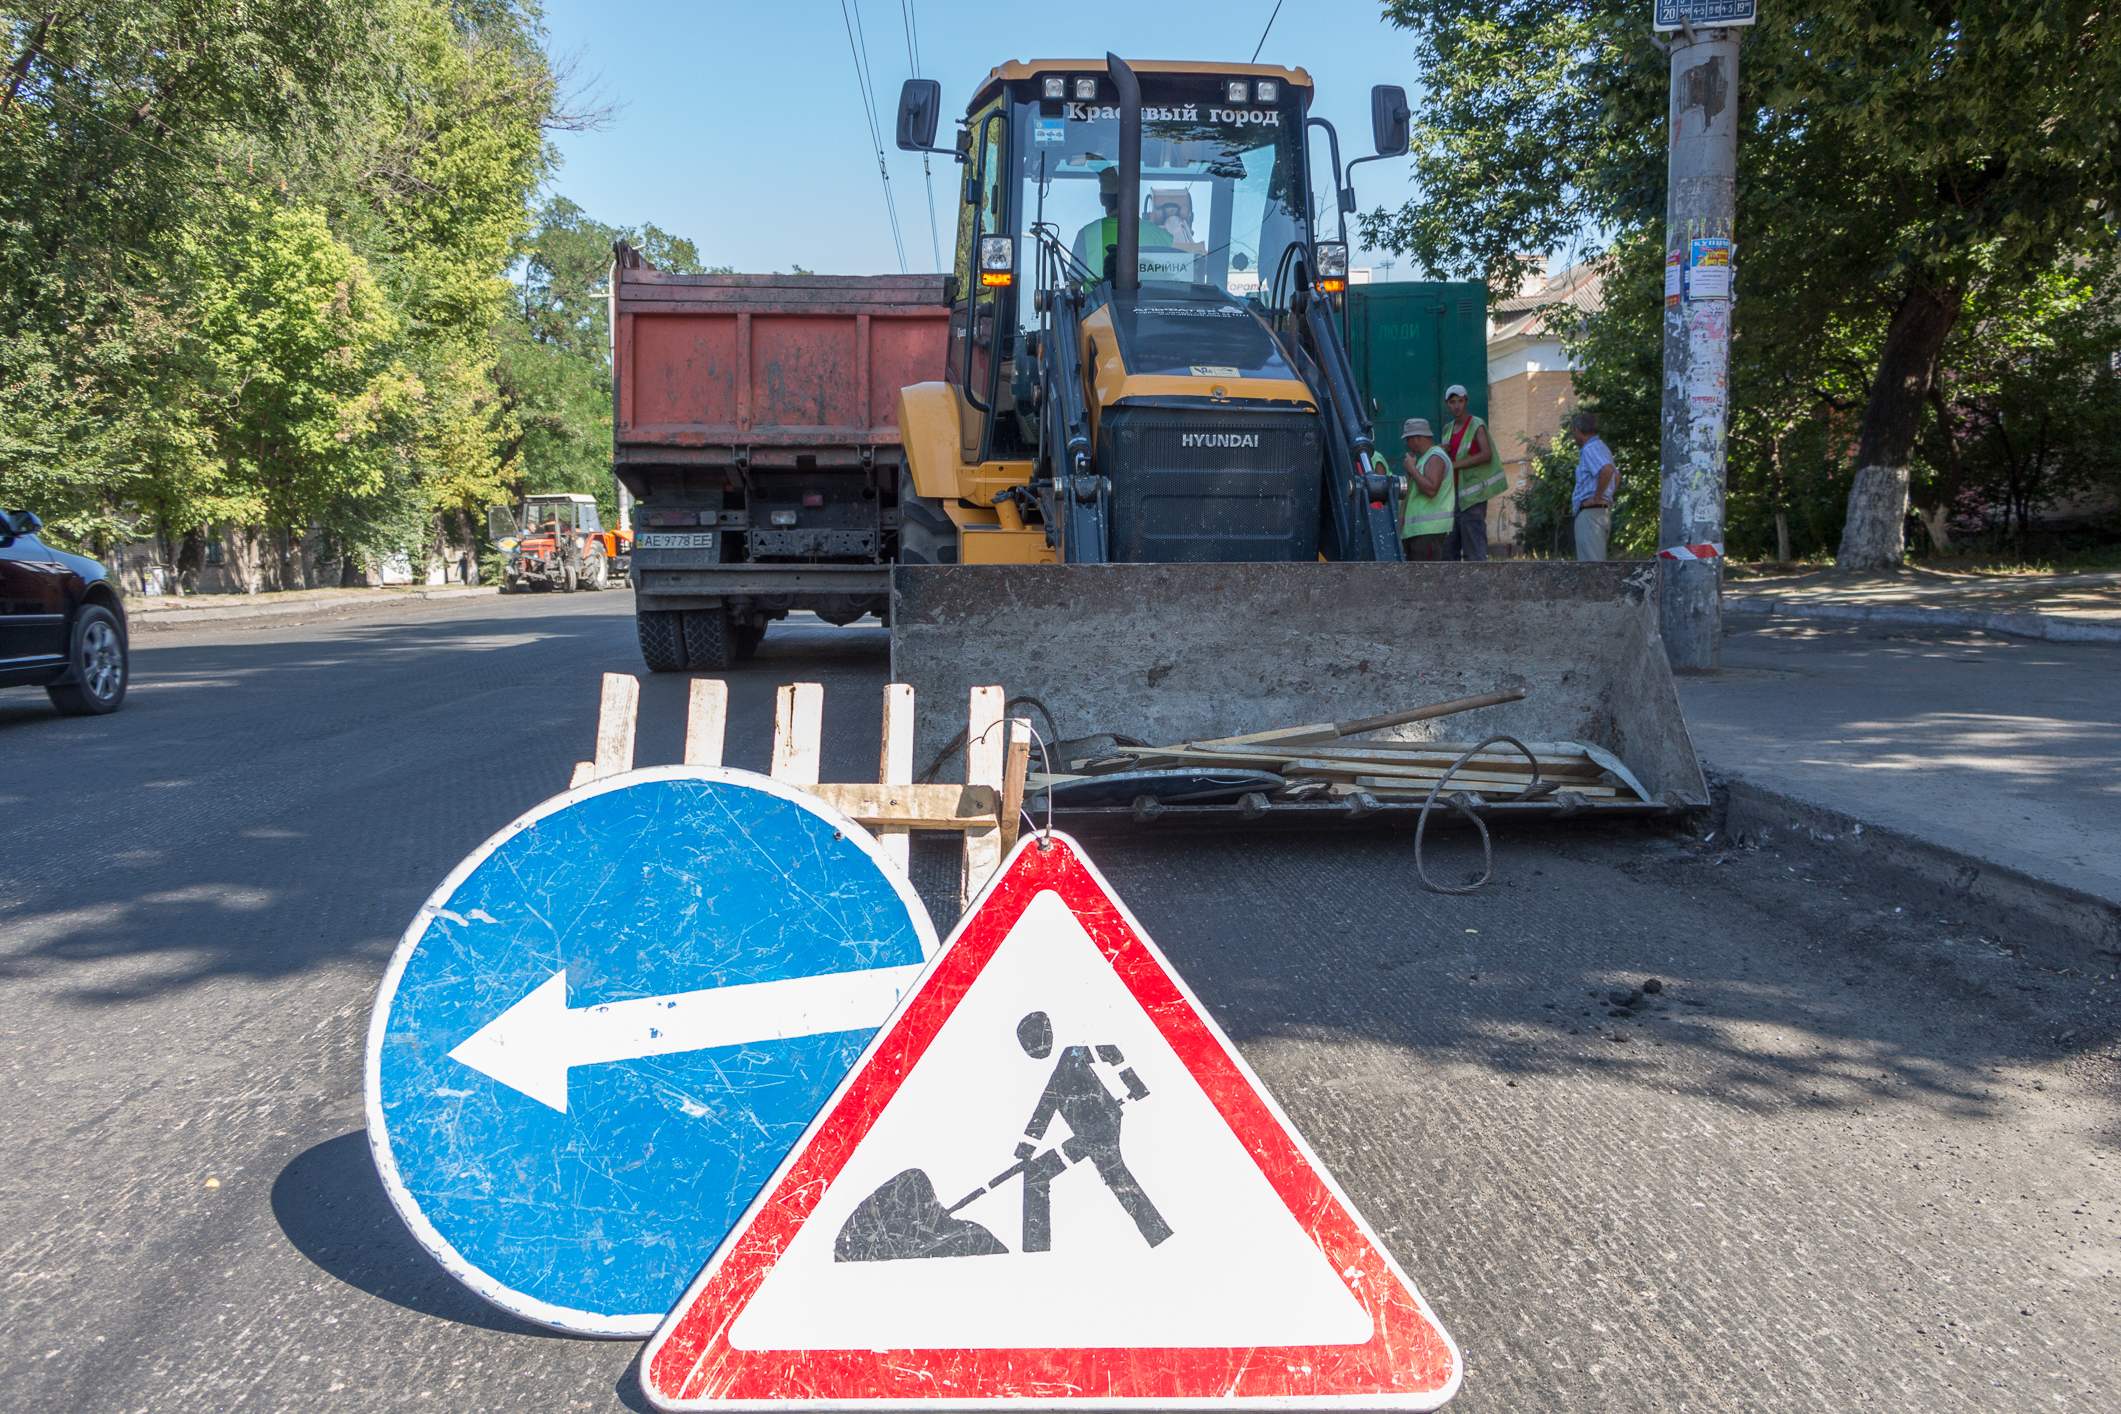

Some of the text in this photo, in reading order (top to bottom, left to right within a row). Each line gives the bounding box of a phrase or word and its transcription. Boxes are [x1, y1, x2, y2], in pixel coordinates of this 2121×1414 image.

[1662, 8, 1676, 20] 20
[1067, 102, 1279, 127] Кравый город
[1138, 261, 1188, 273] ВАРІЙНА
[1182, 433, 1259, 448] HYUNDAI
